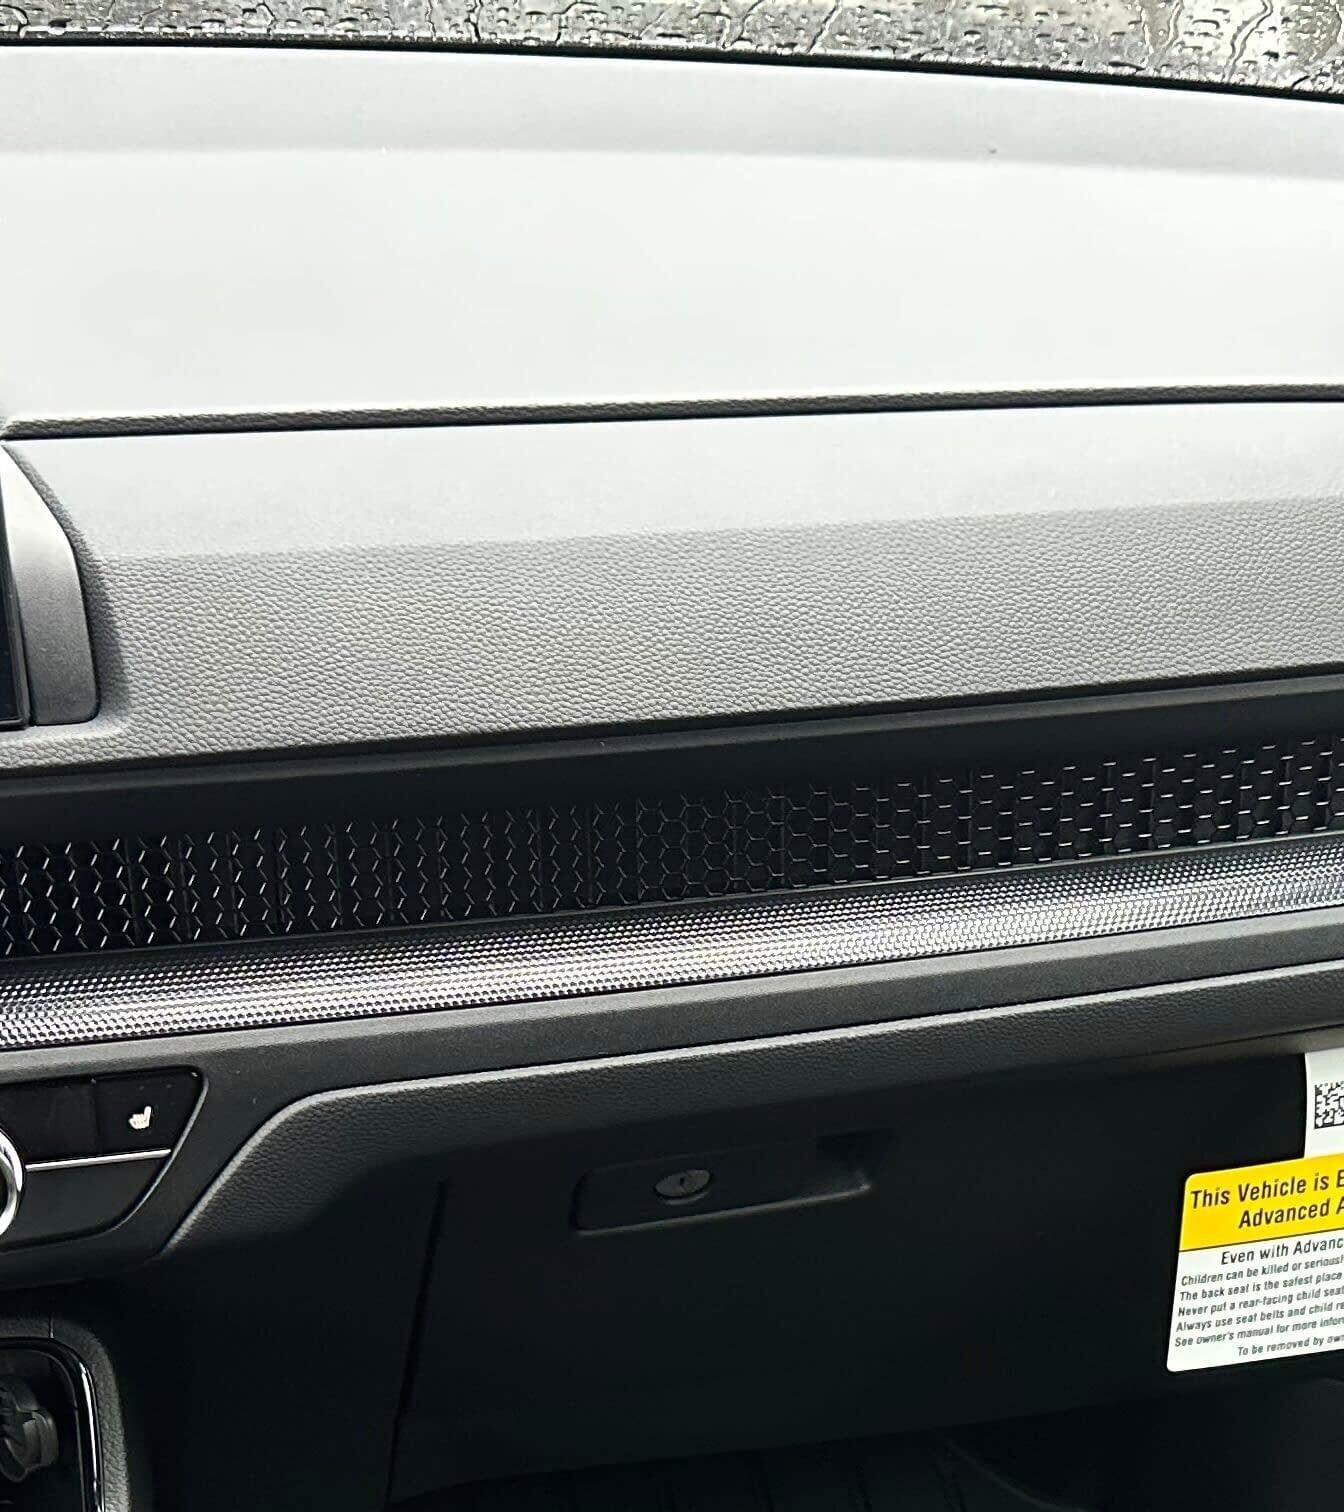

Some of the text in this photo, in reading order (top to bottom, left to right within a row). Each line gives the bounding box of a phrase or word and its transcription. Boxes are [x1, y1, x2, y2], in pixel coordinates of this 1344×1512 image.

[1191, 1188, 1231, 1210] This
[1238, 1175, 1307, 1203] Vehicle
[1313, 1172, 1330, 1192] is
[1237, 1197, 1331, 1230] Advanced
[1221, 1249, 1255, 1266] Even
[1259, 1243, 1290, 1260] with
[1180, 1290, 1198, 1302] The
[1201, 1286, 1225, 1299] back
[1227, 1283, 1250, 1297] seat
[1252, 1281, 1261, 1293] is
[1263, 1279, 1280, 1291] the
[1282, 1273, 1313, 1288] safest
[1315, 1271, 1343, 1286] place
[1181, 1272, 1224, 1288] Children
[1226, 1269, 1244, 1282] can
[1246, 1265, 1259, 1279] be
[1261, 1260, 1289, 1276] killed
[1291, 1260, 1302, 1273] or
[1176, 1319, 1212, 1333] Always
[1214, 1316, 1233, 1328] use
[1235, 1312, 1258, 1325] seat
[1259, 1309, 1285, 1322] belts
[1287, 1305, 1306, 1318] and
[1308, 1301, 1334, 1315] child
[1178, 1305, 1209, 1318] Never
[1210, 1302, 1228, 1315] put
[1229, 1301, 1237, 1311] a
[1238, 1293, 1294, 1309] rear-facing
[1296, 1288, 1321, 1301] child
[1174, 1336, 1194, 1348] See
[1196, 1331, 1234, 1345] owner's
[1236, 1325, 1274, 1339] manual
[1276, 1323, 1289, 1335] for
[1291, 1320, 1318, 1332] more
[1237, 1345, 1249, 1358] To
[1251, 1342, 1264, 1355] be
[1266, 1334, 1310, 1353] removed
[1312, 1334, 1324, 1347] by
